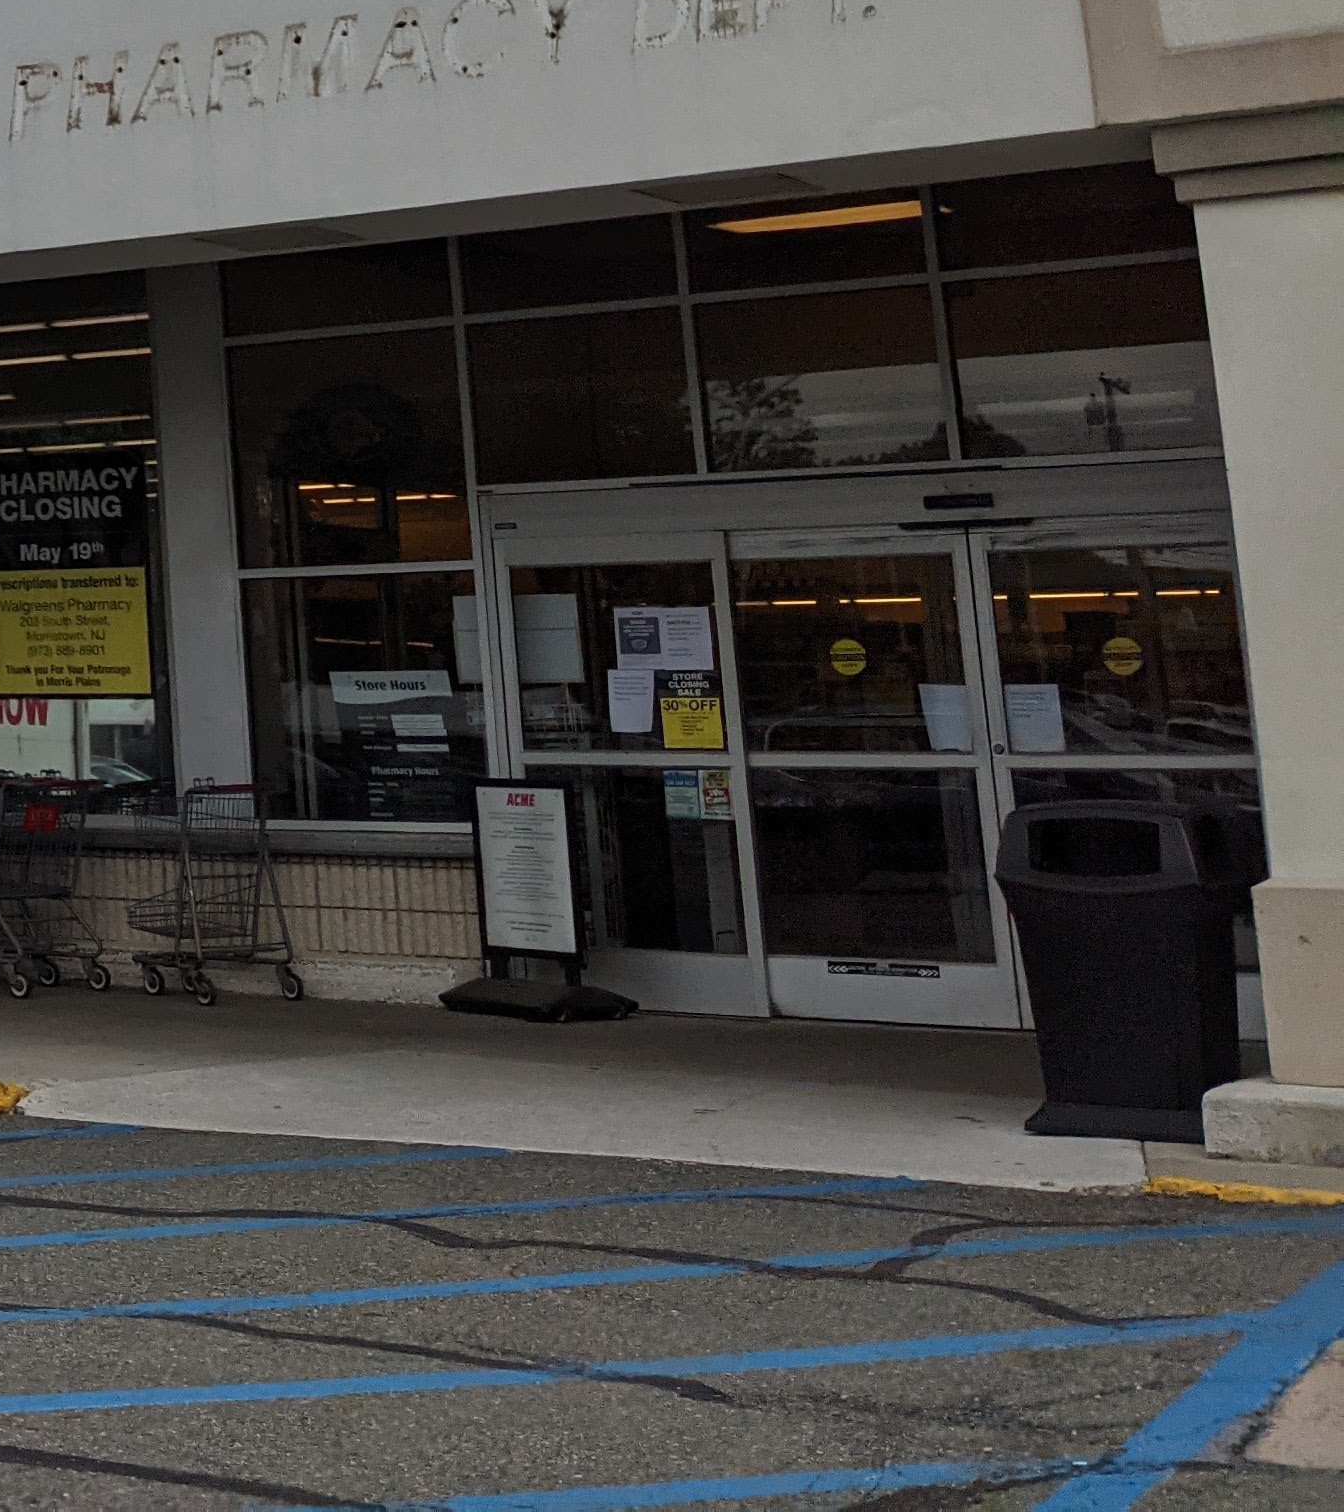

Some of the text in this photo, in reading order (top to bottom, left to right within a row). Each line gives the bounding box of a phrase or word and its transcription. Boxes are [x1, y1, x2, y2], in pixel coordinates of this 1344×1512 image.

[20, 540, 105, 565] May 19th
[62, 574, 122, 589] transferred
[0, 598, 132, 615] Walgreens Pharmacy
[90, 629, 106, 641] NJ
[672, 672, 703, 681] STORE
[355, 679, 427, 691] Store Hours
[667, 680, 710, 689] CLOSING
[677, 688, 702, 697] SALE
[662, 698, 718, 712] 30% OFF
[506, 792, 536, 807] ACME
